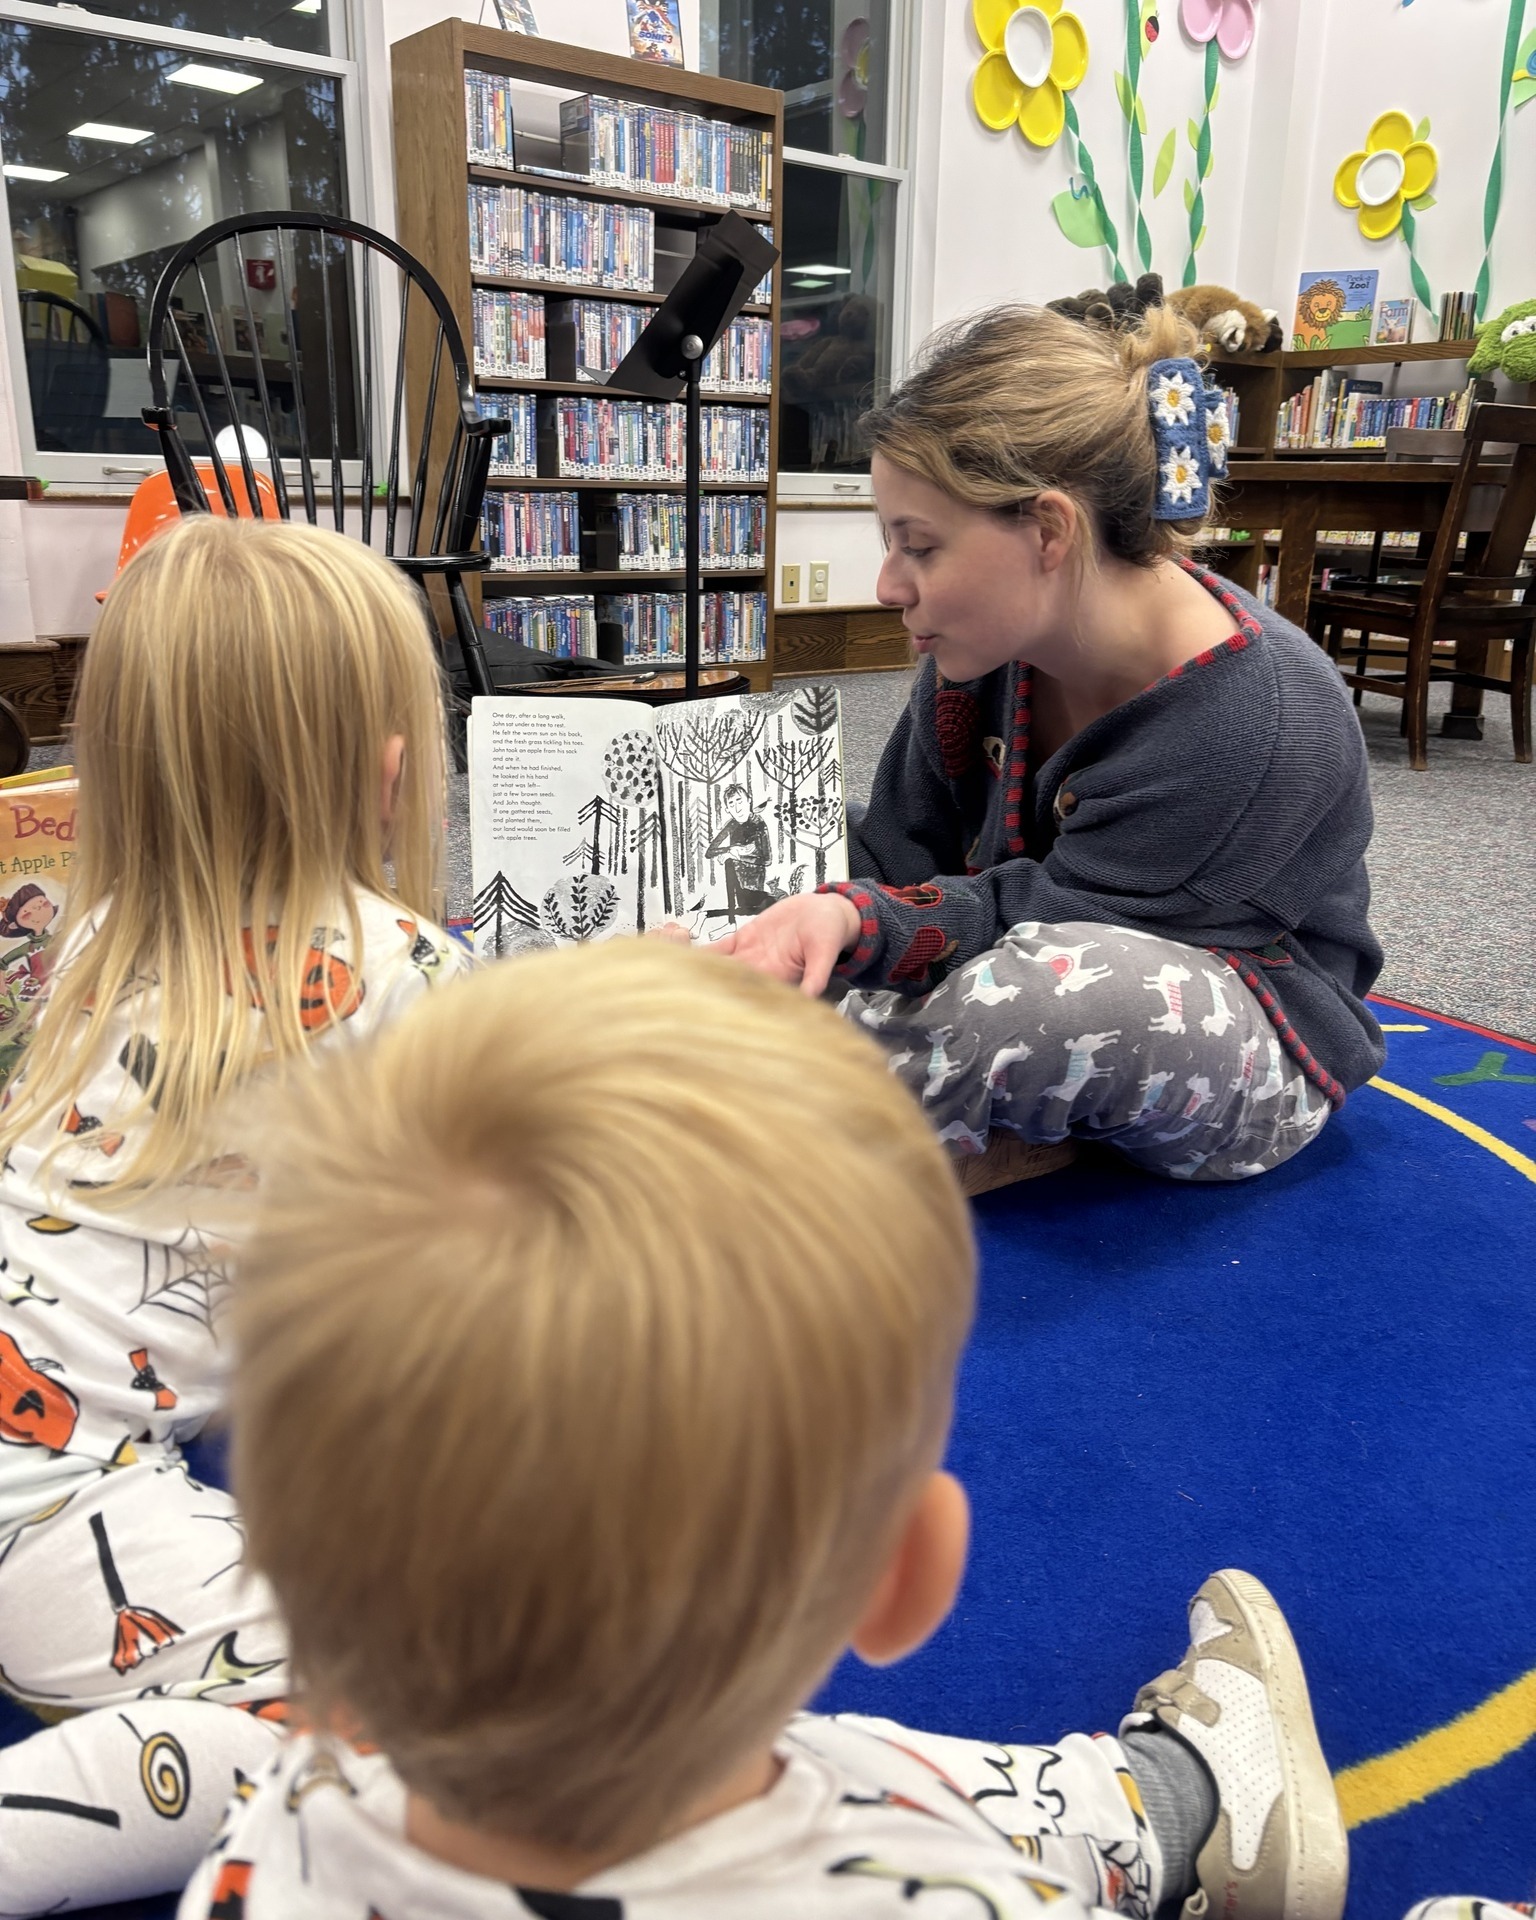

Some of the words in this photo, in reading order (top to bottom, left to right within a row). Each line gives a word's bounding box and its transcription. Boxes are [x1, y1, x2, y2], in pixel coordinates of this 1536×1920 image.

[639, 31, 666, 41] SONIC
[667, 35, 673, 43] 3
[1380, 306, 1408, 318] Farm
[11, 855, 55, 875] Apple
